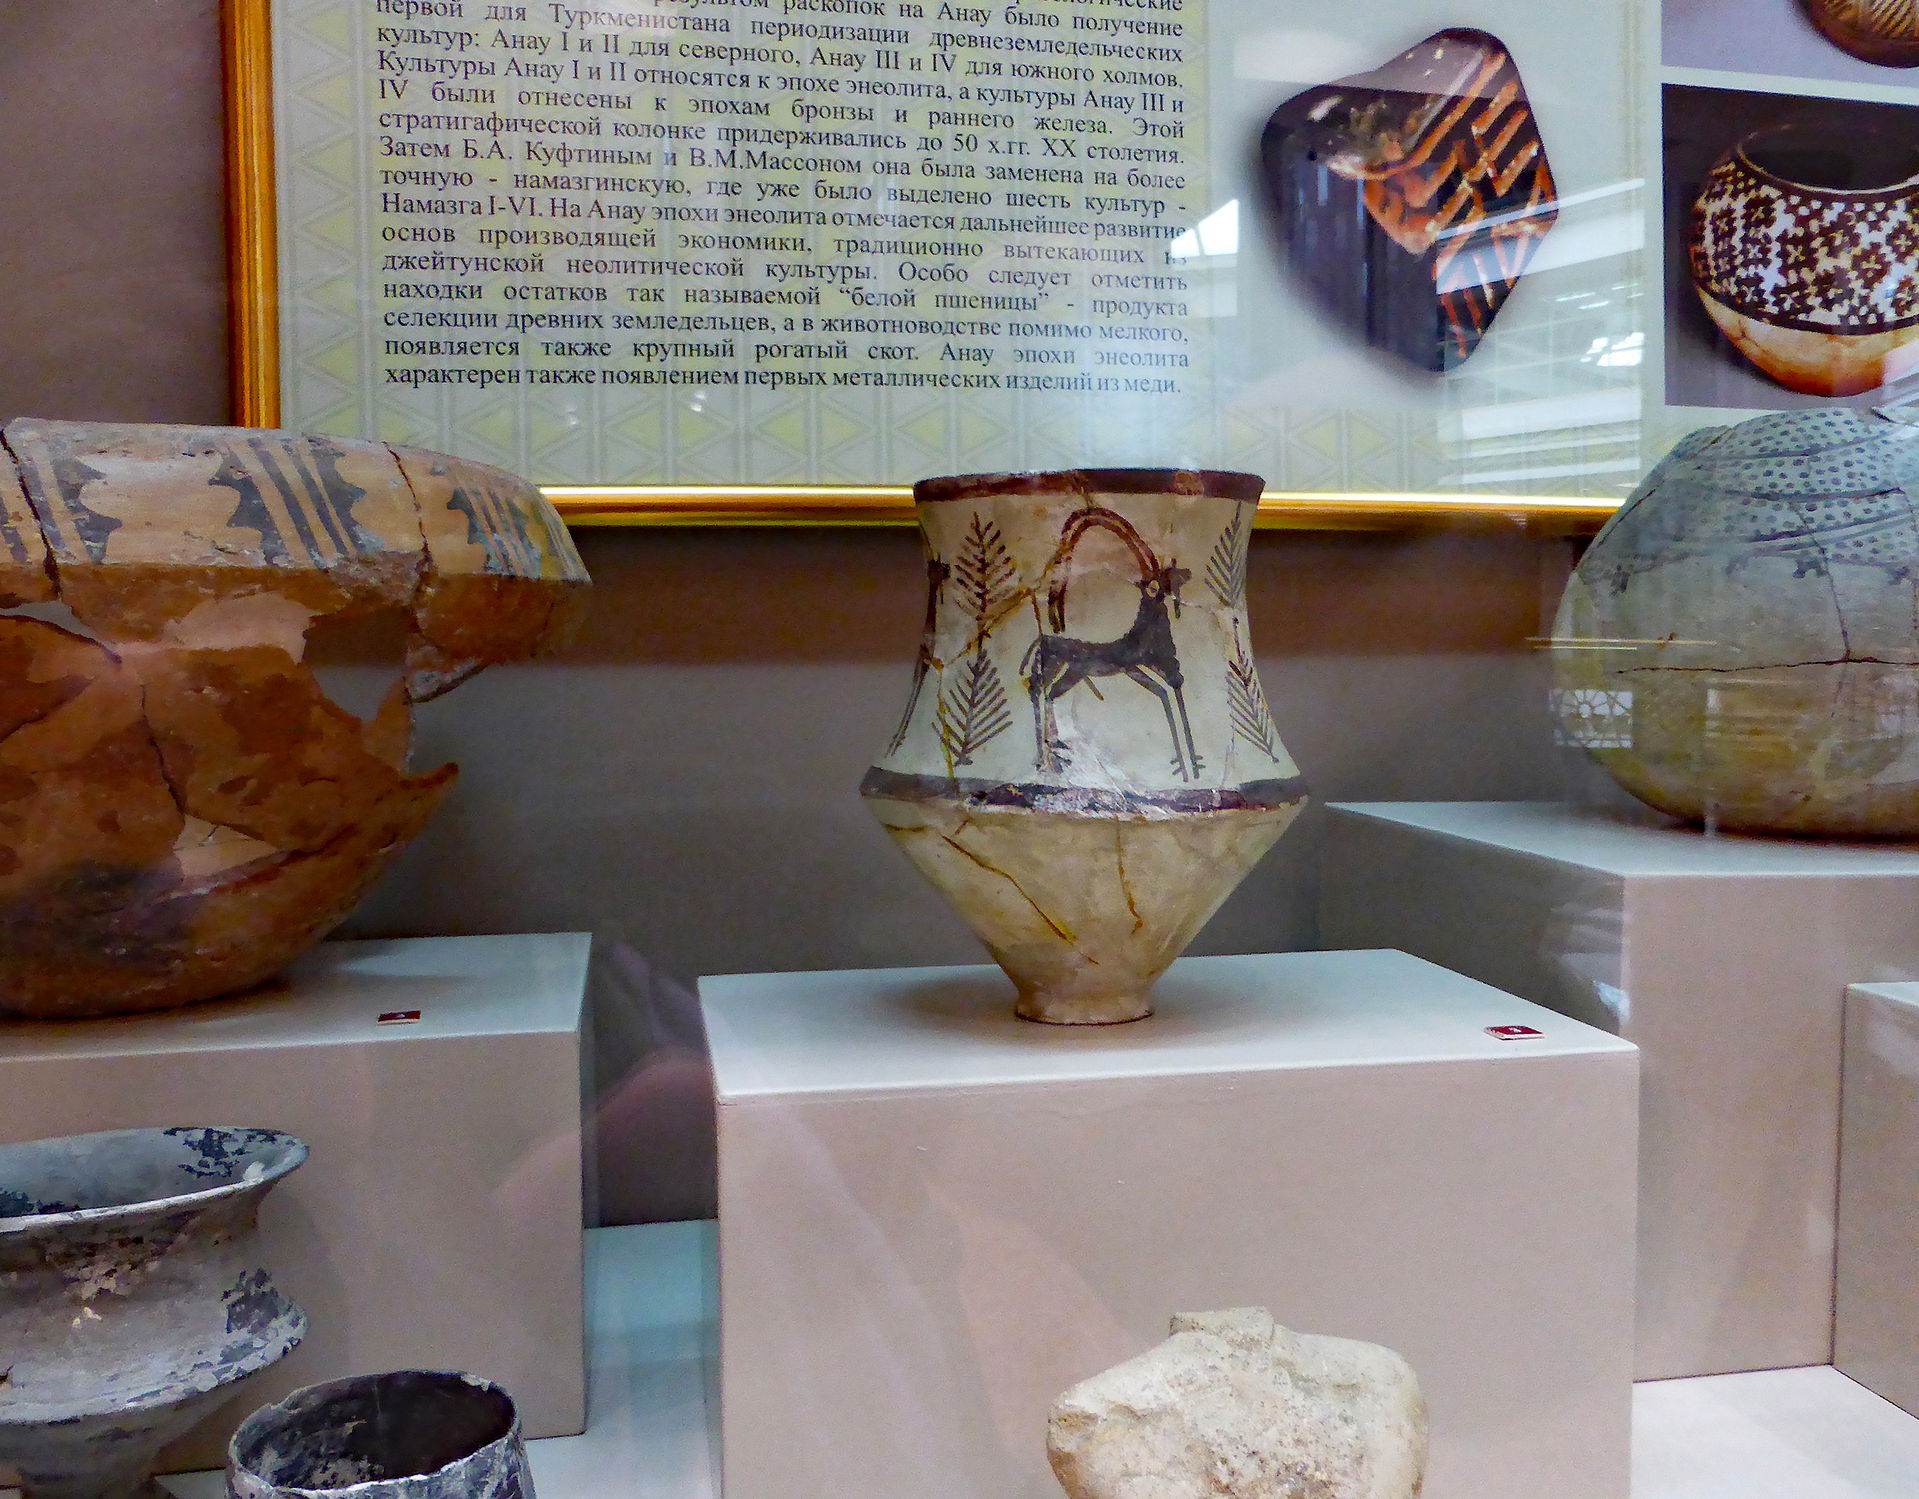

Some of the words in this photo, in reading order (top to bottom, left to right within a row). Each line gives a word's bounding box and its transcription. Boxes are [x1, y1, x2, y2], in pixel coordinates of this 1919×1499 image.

[376, 0, 463, 20] первой
[484, 5, 526, 21] для
[548, 2, 730, 32] Туркменистана
[750, 20, 909, 44] периодизации
[928, 32, 1184, 62] древнеземледельческих
[783, 0, 886, 16] раскопок
[898, 3, 924, 17] на
[936, 1, 992, 27] Анау
[1004, 5, 1060, 27] было
[1072, 15, 1183, 36] получение
[378, 27, 480, 51] культур:
[490, 29, 550, 55] Анау
[562, 31, 568, 50] I
[578, 38, 592, 52] и
[603, 34, 620, 53] II
[628, 40, 669, 56] для
[678, 43, 801, 65] северного,
[809, 46, 866, 72] Анау
[876, 49, 900, 69] III
[909, 57, 922, 70] и
[932, 53, 956, 72] IV
[964, 60, 1002, 76] для
[1011, 63, 1095, 81] южного
[1102, 70, 1183, 87] холмов.
[378, 51, 496, 79] Культуры
[503, 57, 564, 83] Анау
[572, 60, 578, 78] I
[587, 66, 601, 79] и
[610, 62, 626, 81] II
[633, 68, 750, 87] относятся
[758, 75, 770, 89] к
[776, 76, 840, 92] эпохе
[846, 79, 952, 100] энеолита,
[958, 86, 970, 99] а
[976, 87, 1076, 109] культуры
[1082, 89, 1135, 114] Анау
[1142, 92, 1164, 111] III
[1172, 100, 1184, 112] и
[380, 78, 408, 99] IV
[430, 80, 495, 103] были
[517, 90, 631, 109] отнесены
[654, 97, 666, 110] к
[688, 98, 770, 115] эпохам
[791, 98, 874, 123] бронзы
[894, 109, 908, 122] и
[928, 111, 1014, 129] раннего
[1034, 116, 1112, 133] железа.
[1132, 117, 1184, 138] Этой
[378, 113, 600, 137] стратигафической
[612, 122, 706, 139] колонке
[717, 127, 906, 149] придерживались
[916, 137, 943, 150] до
[952, 133, 978, 152] 50
[988, 140, 1030, 155] х.гг.
[1086, 145, 1184, 163] столетия.
[380, 135, 450, 157] Затем
[463, 138, 512, 159] Б.А.
[526, 140, 652, 166] Куфтиным
[664, 152, 677, 166] и
[689, 146, 861, 173] В.М.Массоном
[872, 161, 911, 175] она
[920, 157, 976, 178] была
[985, 166, 1083, 183] заменена
[1094, 171, 1117, 185] на
[1126, 168, 1185, 188] более
[379, 170, 474, 191] точную
[513, 173, 692, 198] намазгинскую,
[706, 181, 742, 196] где
[756, 182, 800, 201] уже
[814, 179, 872, 199] было
[888, 188, 992, 205] выделено
[1005, 193, 1071, 208] шесть
[1084, 196, 1165, 218] культур
[382, 194, 482, 214] Намазга
[488, 196, 542, 216] I-VI.
[550, 198, 582, 217] На
[586, 199, 646, 224] Анау
[651, 206, 718, 221] эпохи
[724, 208, 827, 226] энеолита
[831, 212, 955, 229] отмечается
[959, 215, 1089, 234] дальнейшее
[381, 226, 456, 242] основ
[478, 228, 656, 249] производящей
[678, 234, 812, 251] экономики,
[833, 239, 984, 258] традиционно
[1004, 244, 1144, 263] вытекающих
[381, 251, 544, 276] джейтунской
[566, 257, 744, 276] неолитической
[765, 263, 877, 284] культуры.
[898, 261, 968, 282] Особо
[988, 270, 1072, 290] следует
[1090, 274, 1188, 289] отметить
[383, 283, 482, 300] находки
[503, 285, 608, 301] остатков
[626, 287, 665, 301] так
[684, 286, 820, 304] называемой
[1092, 299, 1188, 319] продукта
[383, 311, 498, 328] селекции
[504, 313, 604, 333] древних
[612, 314, 776, 333] земледельцев,
[782, 317, 794, 331] а
[802, 317, 814, 331] в
[820, 318, 1001, 335] животноводстве
[1008, 322, 1092, 337] помимо
[1098, 326, 1188, 344] мелкого,
[384, 340, 520, 355] появляется
[540, 341, 612, 356] также
[632, 338, 734, 362] крупный
[754, 340, 848, 363] рогатый
[867, 345, 919, 360] скот.
[939, 342, 994, 366] Анау
[1013, 349, 1074, 363] эпохи
[1094, 351, 1188, 367] энеолита
[384, 368, 520, 388] характерен
[524, 369, 596, 383] также
[601, 369, 739, 384] появлением
[744, 370, 828, 390] первых
[832, 372, 1002, 388] металлических
[1005, 372, 1092, 390] изделий
[1097, 378, 1120, 390] из
[1124, 378, 1180, 392] меди.
